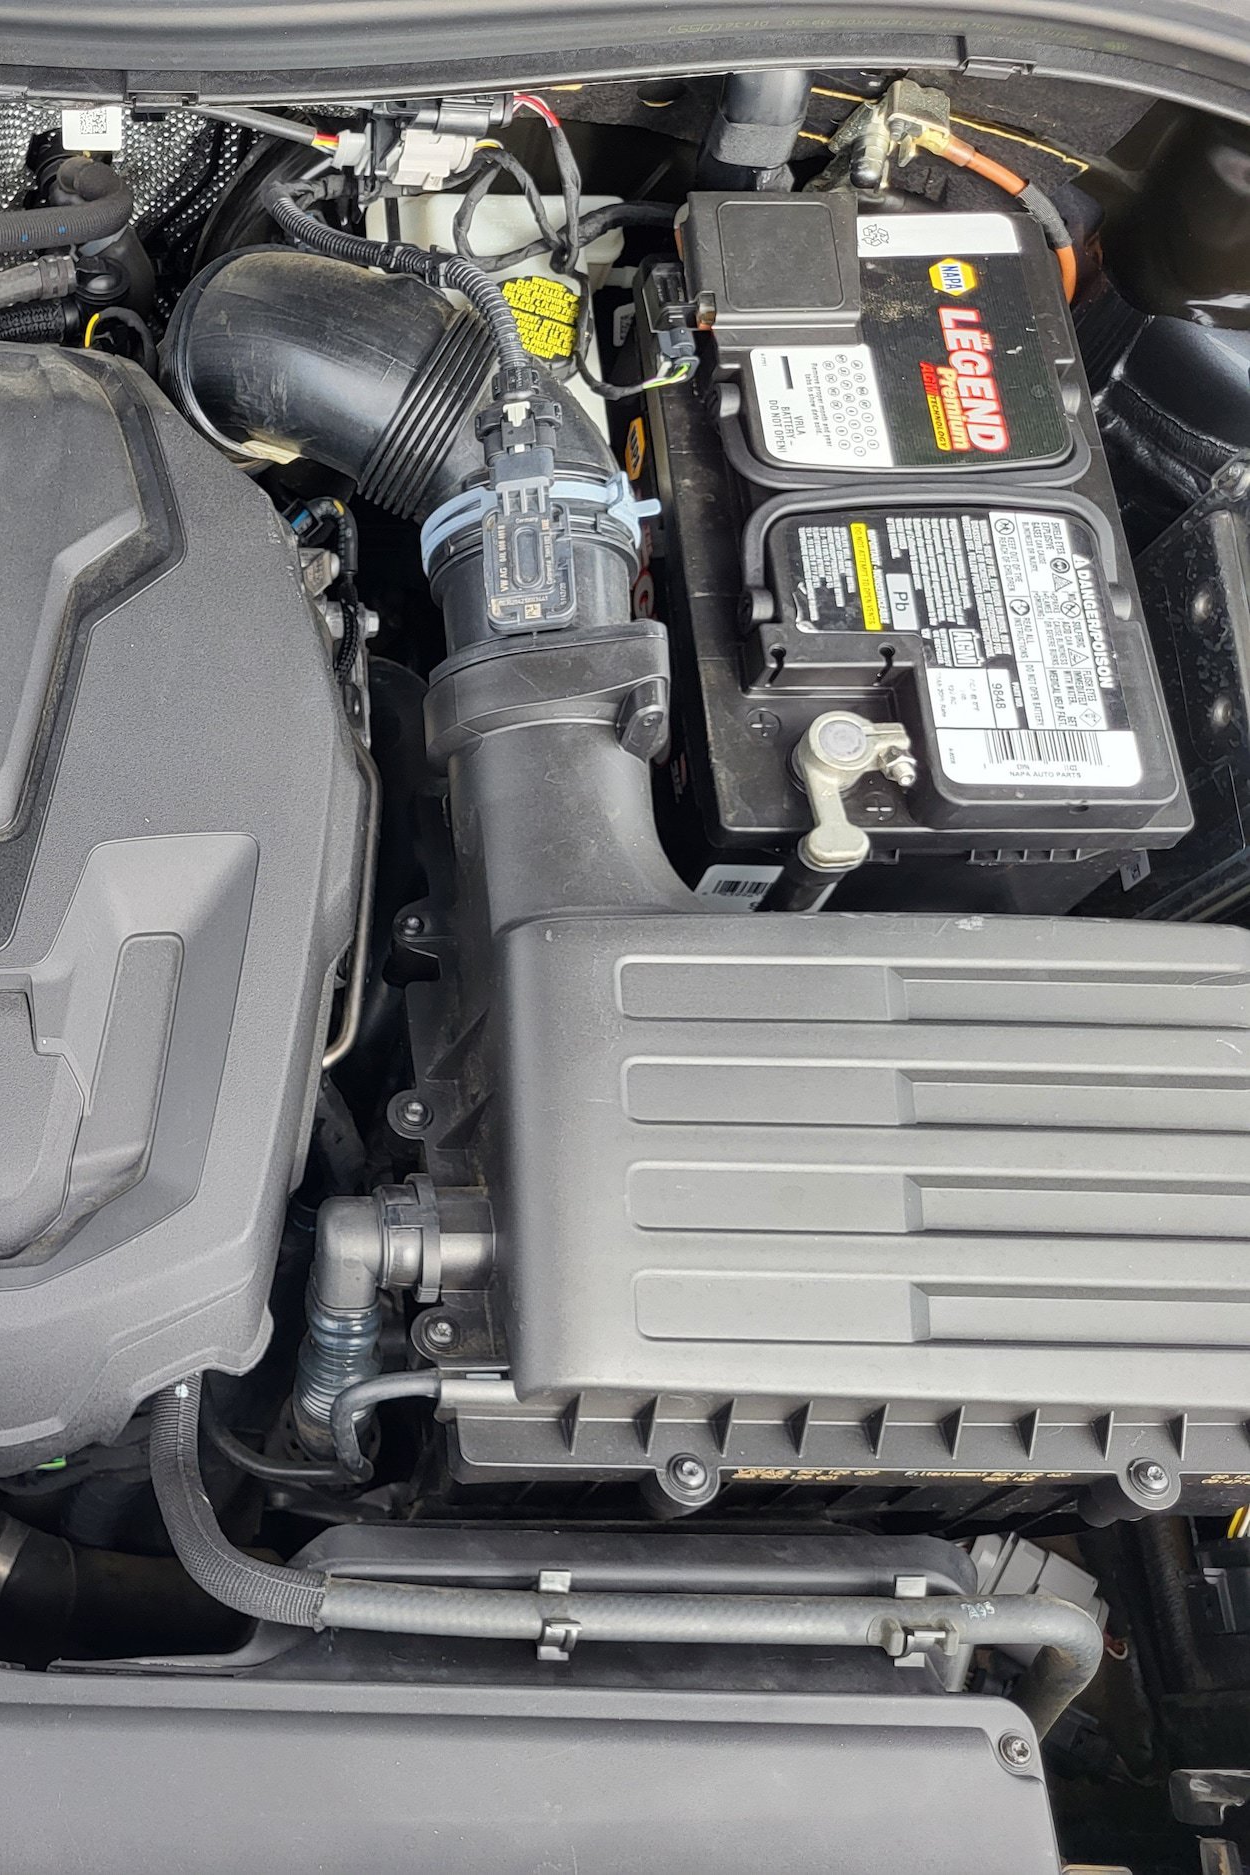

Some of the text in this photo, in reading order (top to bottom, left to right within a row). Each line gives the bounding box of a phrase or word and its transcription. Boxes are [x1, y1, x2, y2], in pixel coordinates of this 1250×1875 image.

[941, 266, 963, 289] NAPA
[981, 334, 992, 350] THE
[810, 363, 820, 384] Remove
[939, 307, 1008, 452] LEGEND
[808, 394, 817, 407] show
[812, 386, 823, 404] proper
[920, 362, 948, 447] AGM TECHNOLOGY
[810, 409, 820, 420] date
[818, 405, 828, 422] month
[936, 368, 969, 450] Premium
[768, 400, 787, 453] DO NOT OPEN!
[780, 406, 796, 439] BATTERY
[793, 416, 806, 436] VRLA
[821, 434, 832, 447] year
[855, 526, 864, 535] DO
[1041, 522, 1055, 550] EXPLOSIVE
[1051, 522, 1063, 540] SHIELD
[856, 536, 866, 548] NOT
[998, 537, 1008, 555] REACH
[1007, 537, 1017, 550] KEEP
[1031, 522, 1043, 538] GASES
[1037, 550, 1047, 565] CAUSE
[858, 549, 869, 577] ATTEMPT
[1010, 552, 1020, 563] OUT
[499, 567, 508, 579] AG
[1015, 573, 1023, 583] THE
[862, 587, 873, 603] OPEN
[893, 591, 909, 612] Pb
[1014, 617, 1028, 659] INSTRUCTIONS
[1022, 617, 1035, 643] READ ALL
[1062, 621, 1072, 635] ACID
[1072, 621, 1085, 648] SULFURIC
[1076, 570, 1114, 689] DANGER/POISON
[952, 631, 977, 665] AGM
[1027, 674, 1037, 685] NOT
[1049, 670, 1062, 694] MEDICAL
[1063, 670, 1073, 684] WITH
[1083, 670, 1097, 702] FLUSH EYES
[991, 683, 1006, 709] 9848
[1029, 686, 1039, 700] OPEN
[1073, 670, 1088, 706] IMMEDIATELY
[1054, 696, 1064, 709] HELP
